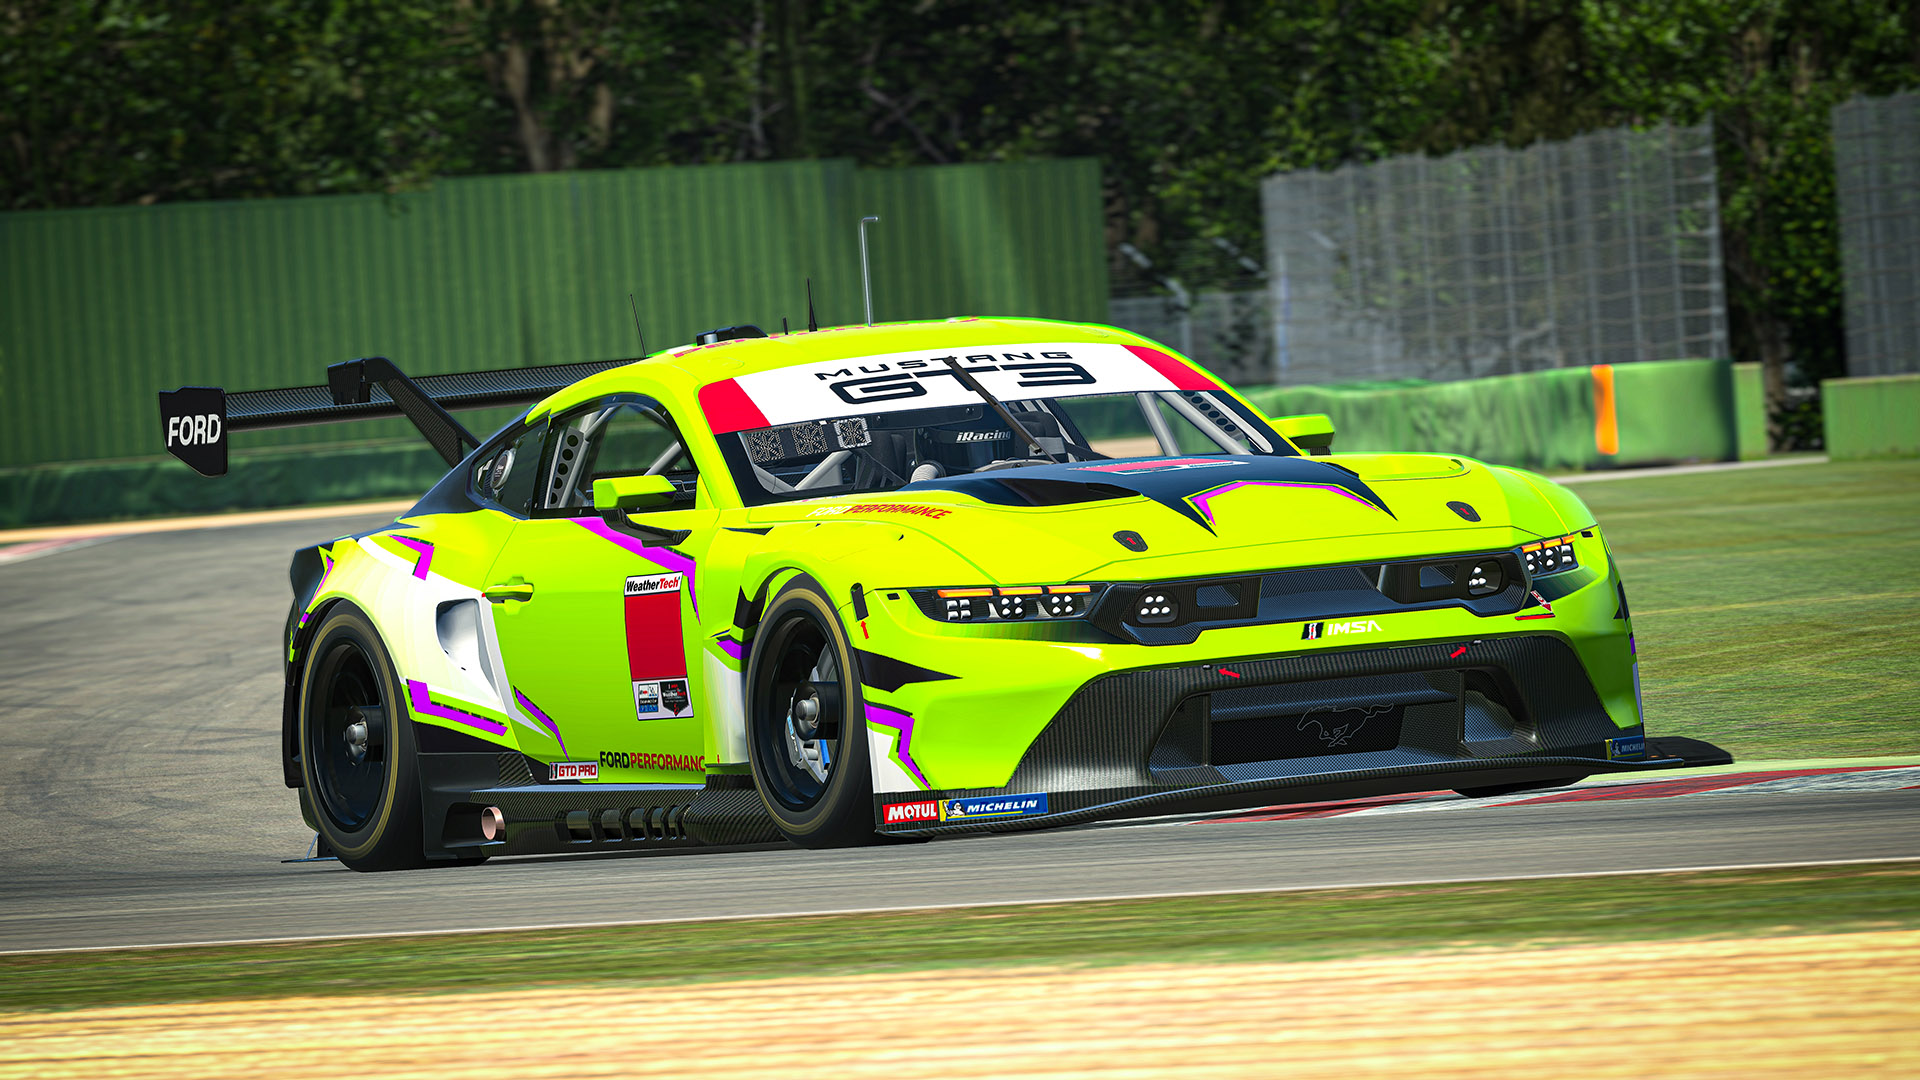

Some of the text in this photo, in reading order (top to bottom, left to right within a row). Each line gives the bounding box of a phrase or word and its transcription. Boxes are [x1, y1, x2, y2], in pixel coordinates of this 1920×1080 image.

[814, 351, 1073, 381] MUSTANG
[829, 362, 1097, 405] GT3
[167, 413, 222, 447] FORD
[955, 429, 1012, 442] iRacing
[626, 576, 681, 593] WeatherTech
[1327, 619, 1385, 636] IMSA
[558, 764, 597, 778] GTD PRO
[887, 802, 937, 821] MOTUL
[966, 799, 1038, 813] MICHELIN
